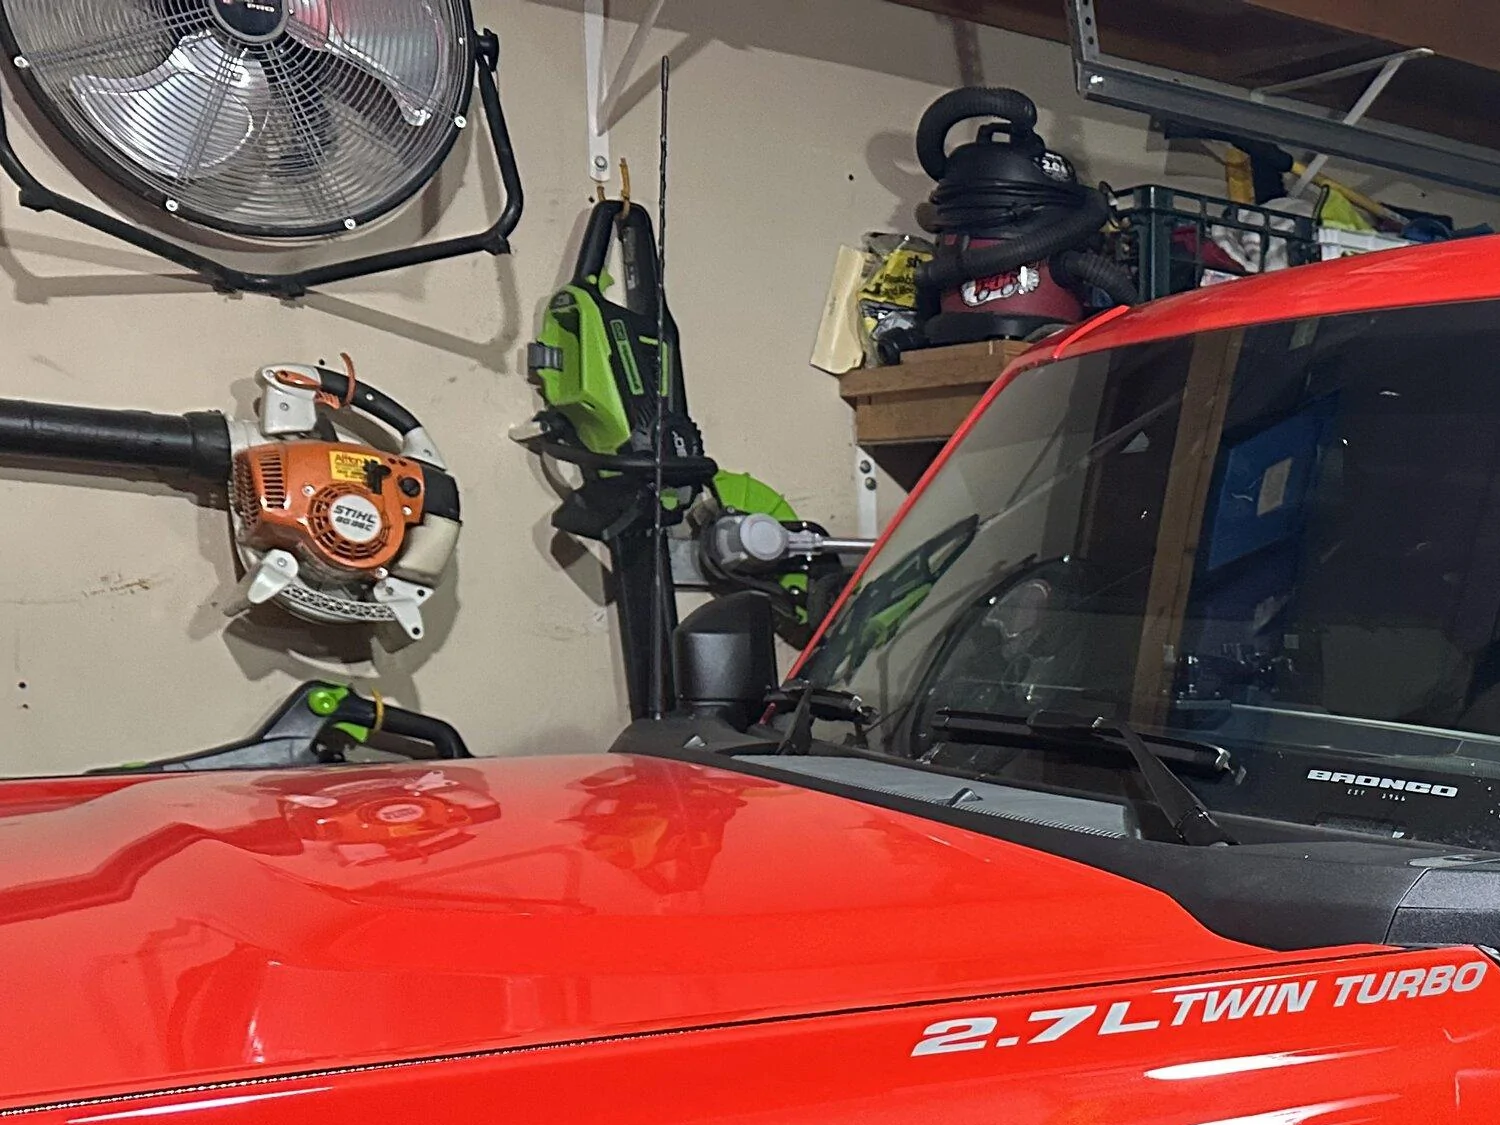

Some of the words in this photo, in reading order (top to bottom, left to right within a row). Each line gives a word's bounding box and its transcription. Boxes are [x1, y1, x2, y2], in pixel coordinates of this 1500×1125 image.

[333, 505, 376, 524] STIHL
[1306, 769, 1459, 798] BRONCO
[1381, 792, 1406, 802] 1966
[1170, 980, 1318, 1027] TWIN
[1333, 961, 1489, 1008] TURBO
